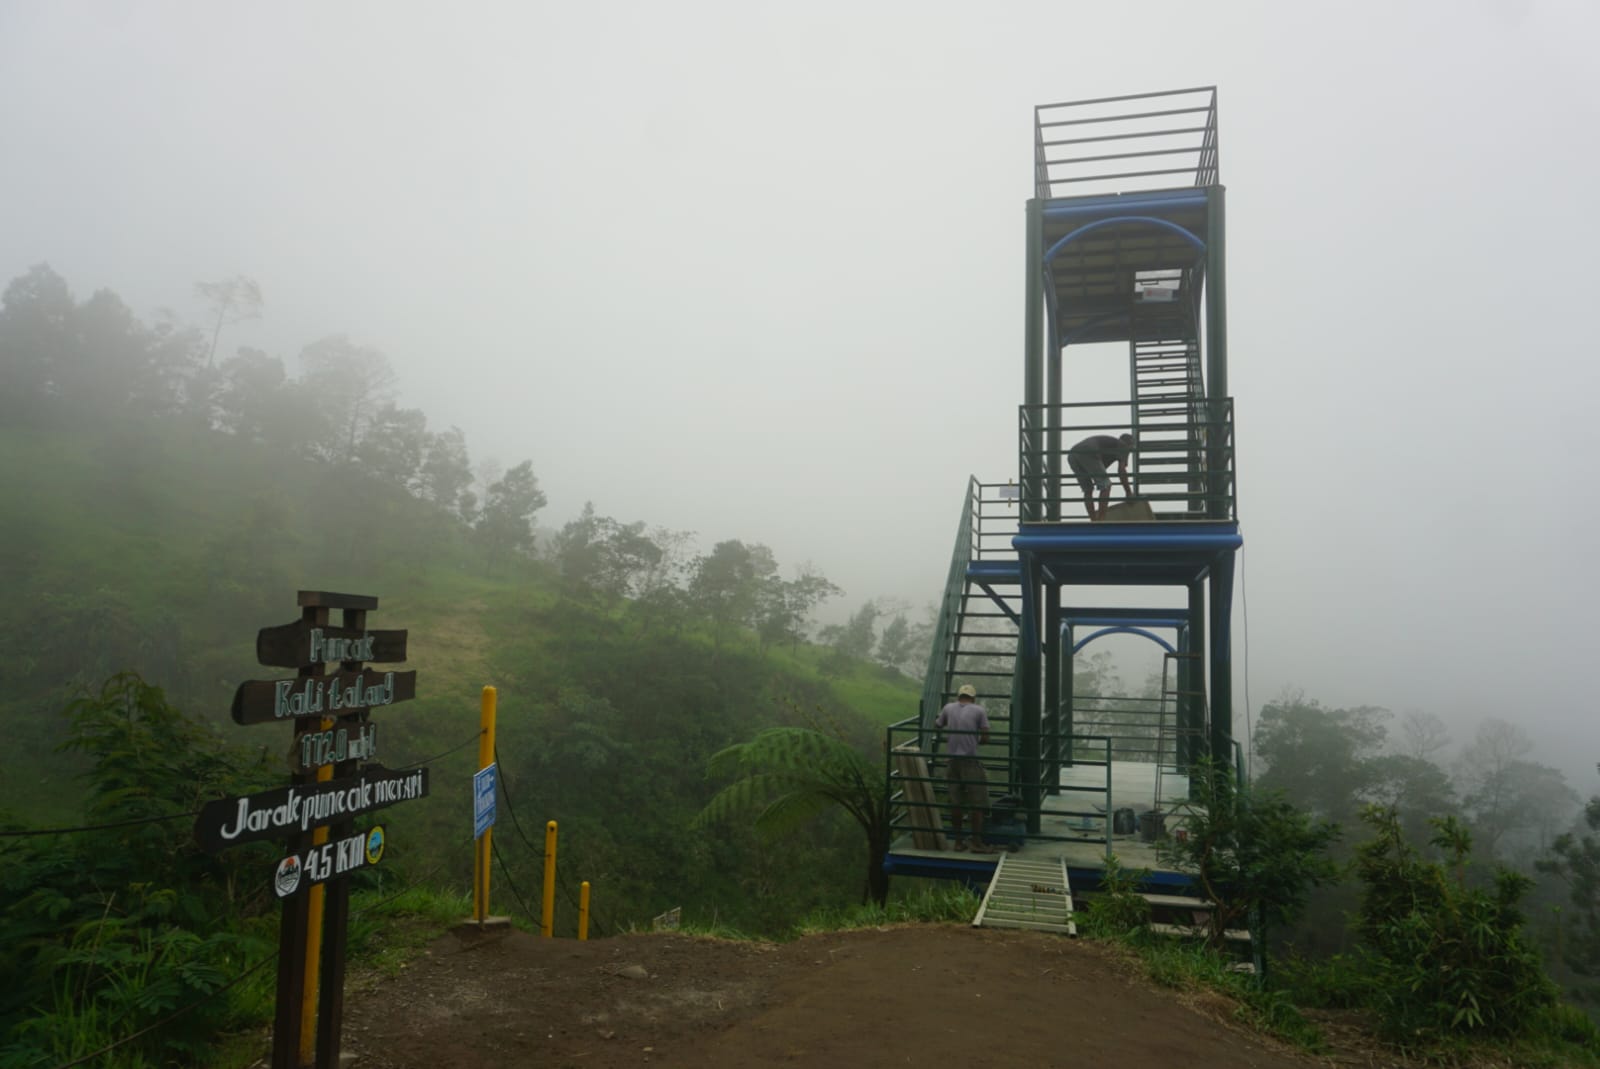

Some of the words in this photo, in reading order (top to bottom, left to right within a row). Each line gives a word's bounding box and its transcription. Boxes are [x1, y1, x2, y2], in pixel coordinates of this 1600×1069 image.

[310, 628, 375, 663] Puncak
[274, 679, 324, 718] Kali
[220, 789, 302, 840] Jarak
[301, 778, 372, 831] puncak
[374, 770, 424, 803] merapi
